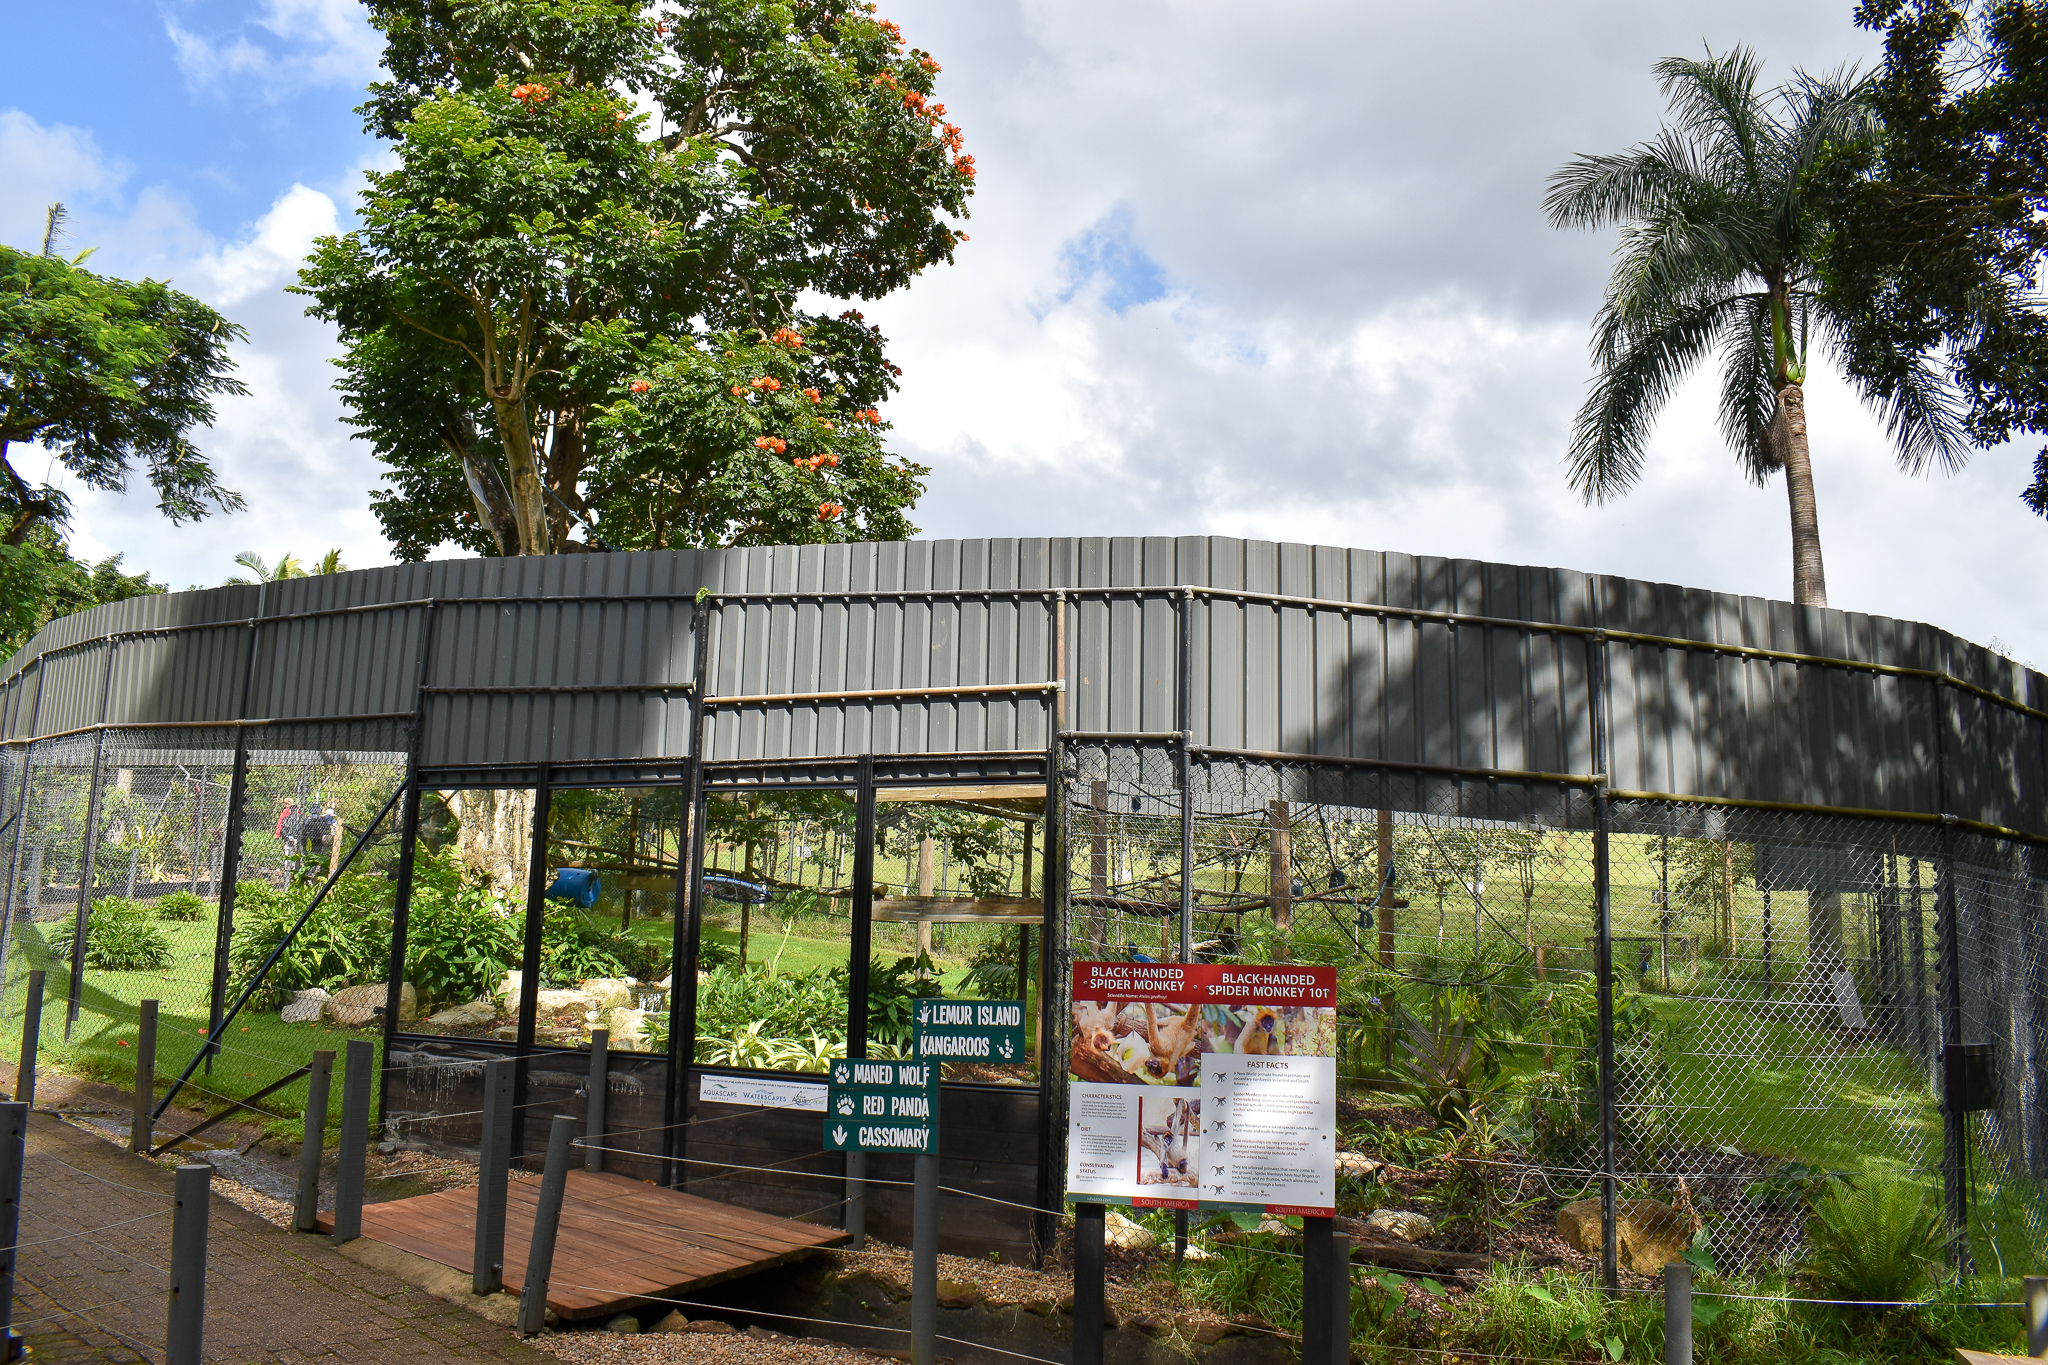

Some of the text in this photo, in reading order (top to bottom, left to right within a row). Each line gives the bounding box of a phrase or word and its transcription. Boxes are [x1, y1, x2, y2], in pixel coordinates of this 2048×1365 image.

[1091, 966, 1184, 980] BLACK-HANDED
[1222, 973, 1315, 986] BLACK-HANDED
[1090, 978, 1185, 992] SPIDER MONKEY
[1208, 984, 1328, 998] SPIDER MONKEY 101
[932, 1005, 1020, 1026] LEMUR ISLAND
[919, 1035, 990, 1057] KANGAROOS
[854, 1064, 930, 1086] MANED WOLF
[703, 1089, 737, 1097] AQUASCAPE
[743, 1092, 786, 1102] WATERSCAPES
[863, 1095, 930, 1117] RED PANDA
[858, 1127, 930, 1148] CASSOWARY
[1163, 1200, 1190, 1208] AMERICA
[1297, 1207, 1325, 1216] AMERICA
